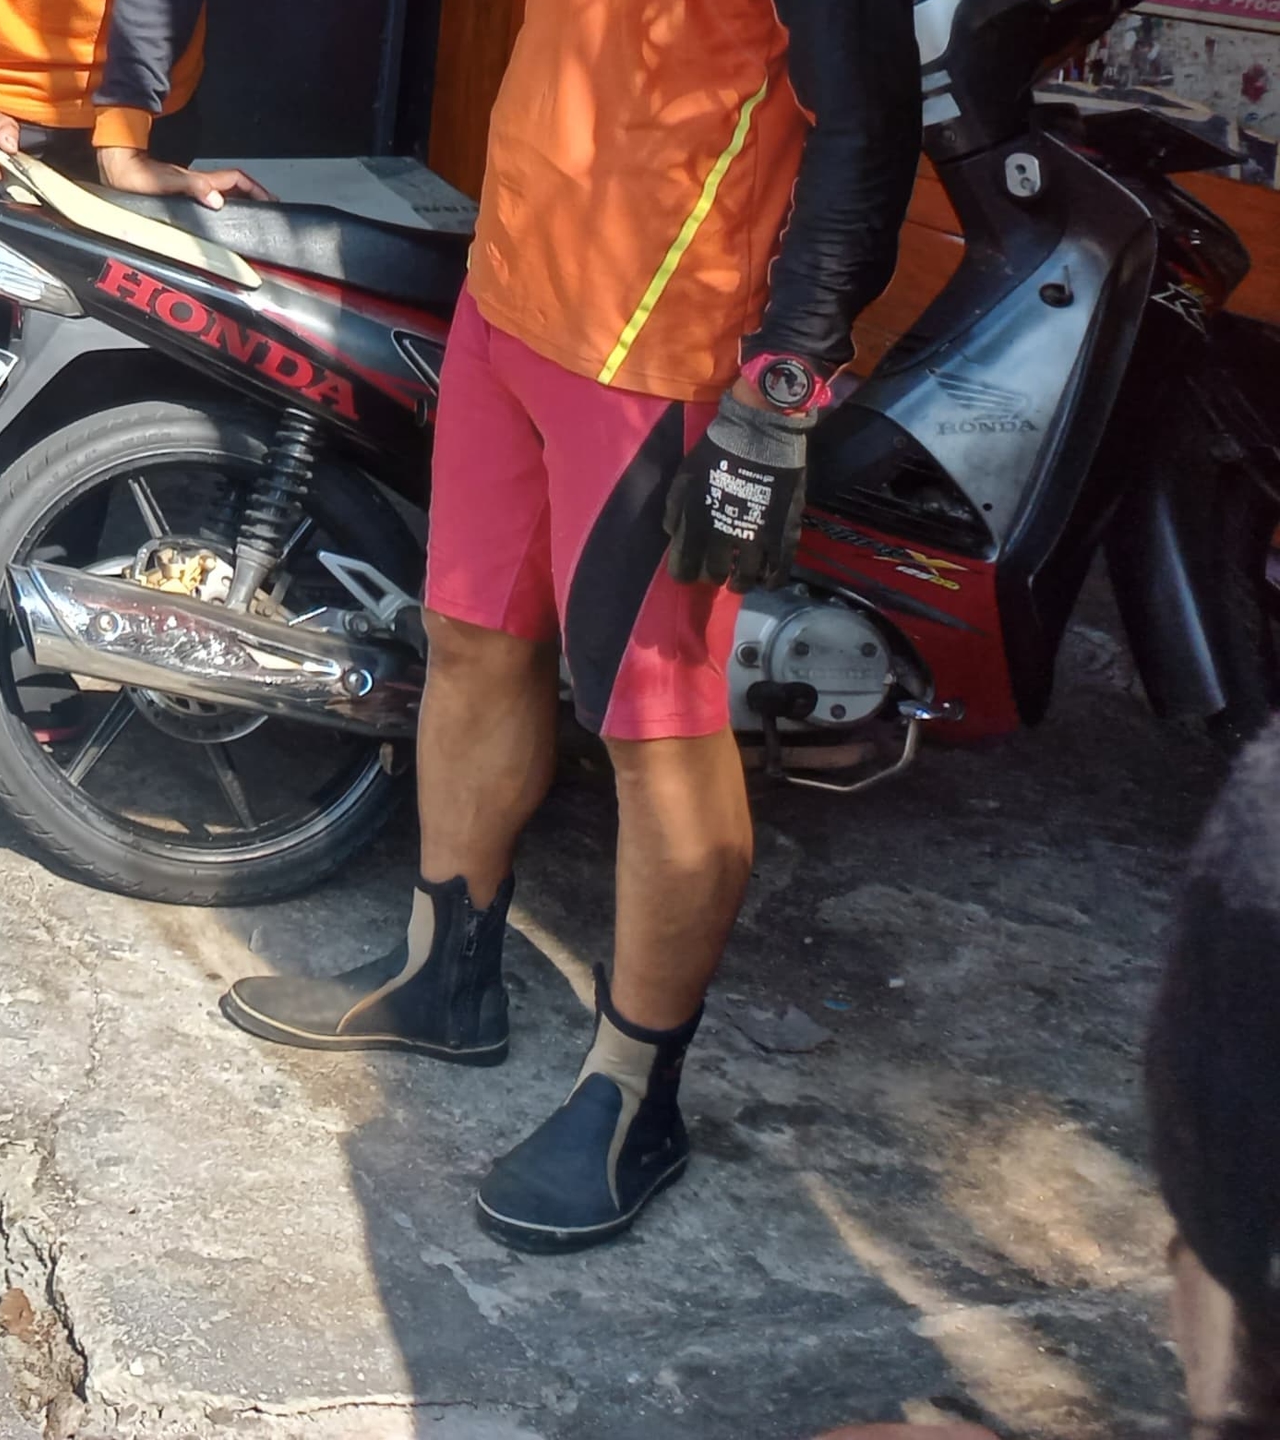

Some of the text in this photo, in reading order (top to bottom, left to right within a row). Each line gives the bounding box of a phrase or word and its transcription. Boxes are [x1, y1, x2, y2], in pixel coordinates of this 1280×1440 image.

[94, 256, 360, 422] HONDA
[936, 418, 1040, 437] HONDA
[712, 518, 756, 541] uvex
